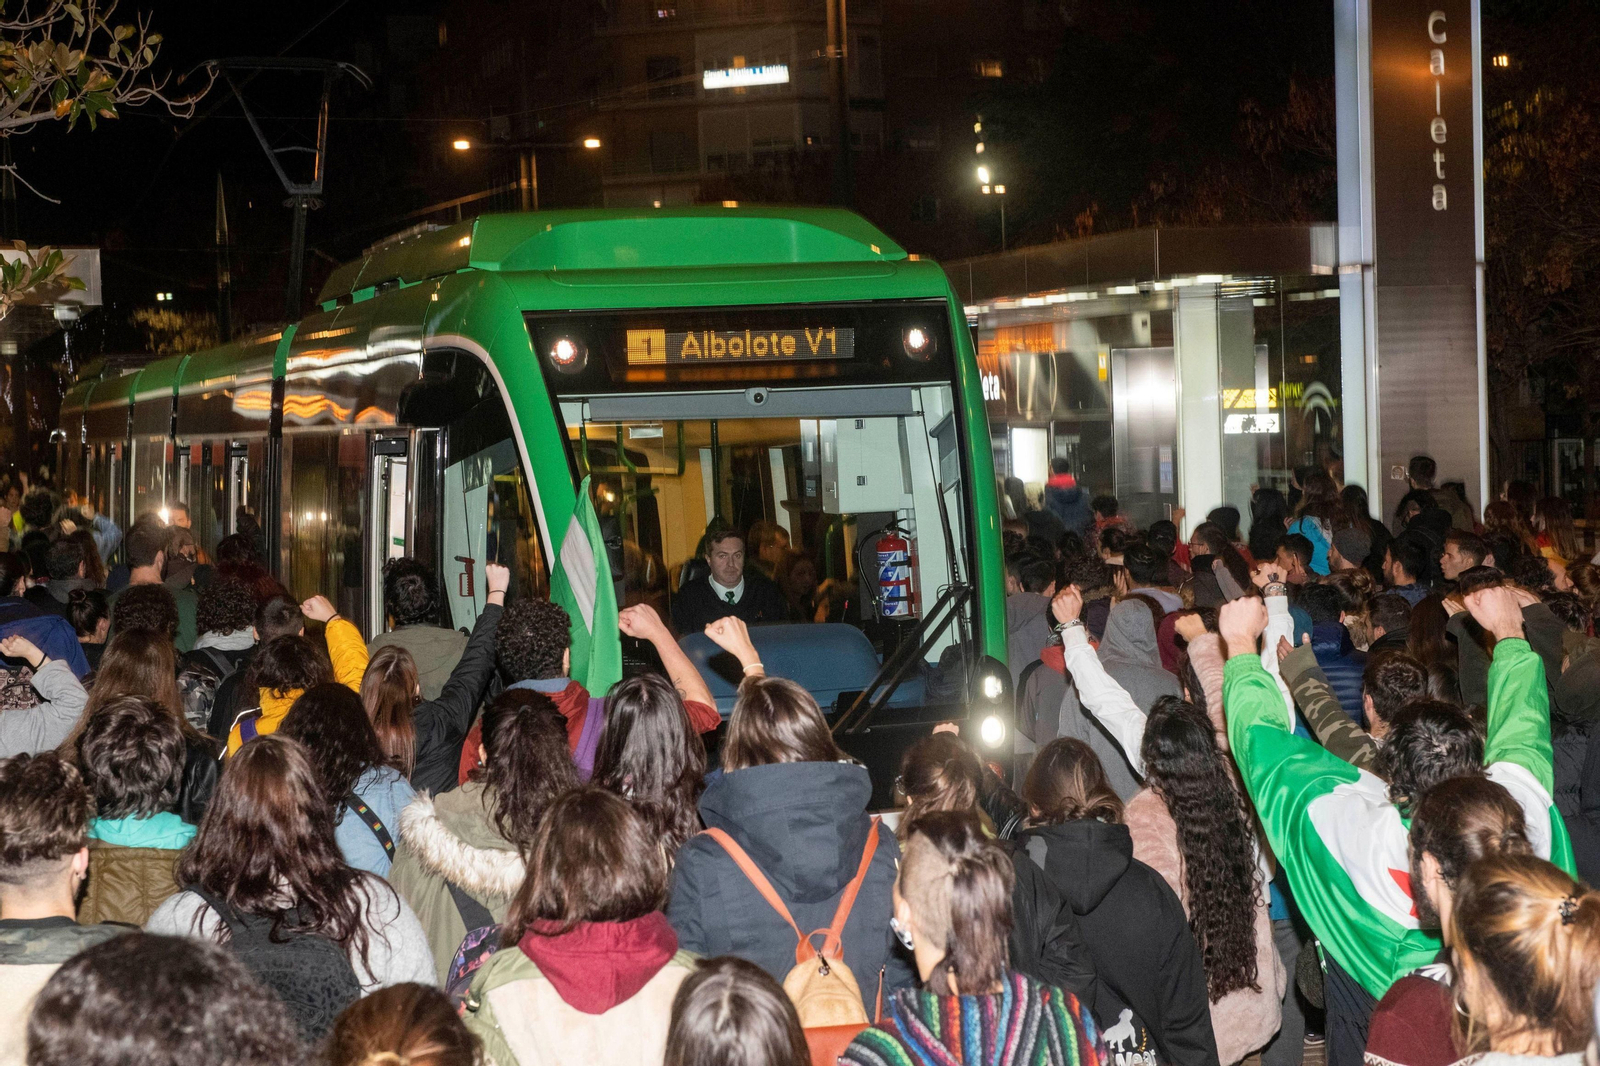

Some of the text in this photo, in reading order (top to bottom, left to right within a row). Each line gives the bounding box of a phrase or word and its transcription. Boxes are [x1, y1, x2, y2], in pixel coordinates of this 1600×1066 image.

[1428, 10, 1448, 211] Caleta
[681, 329, 797, 359] Albolote
[804, 327, 836, 355] V1
